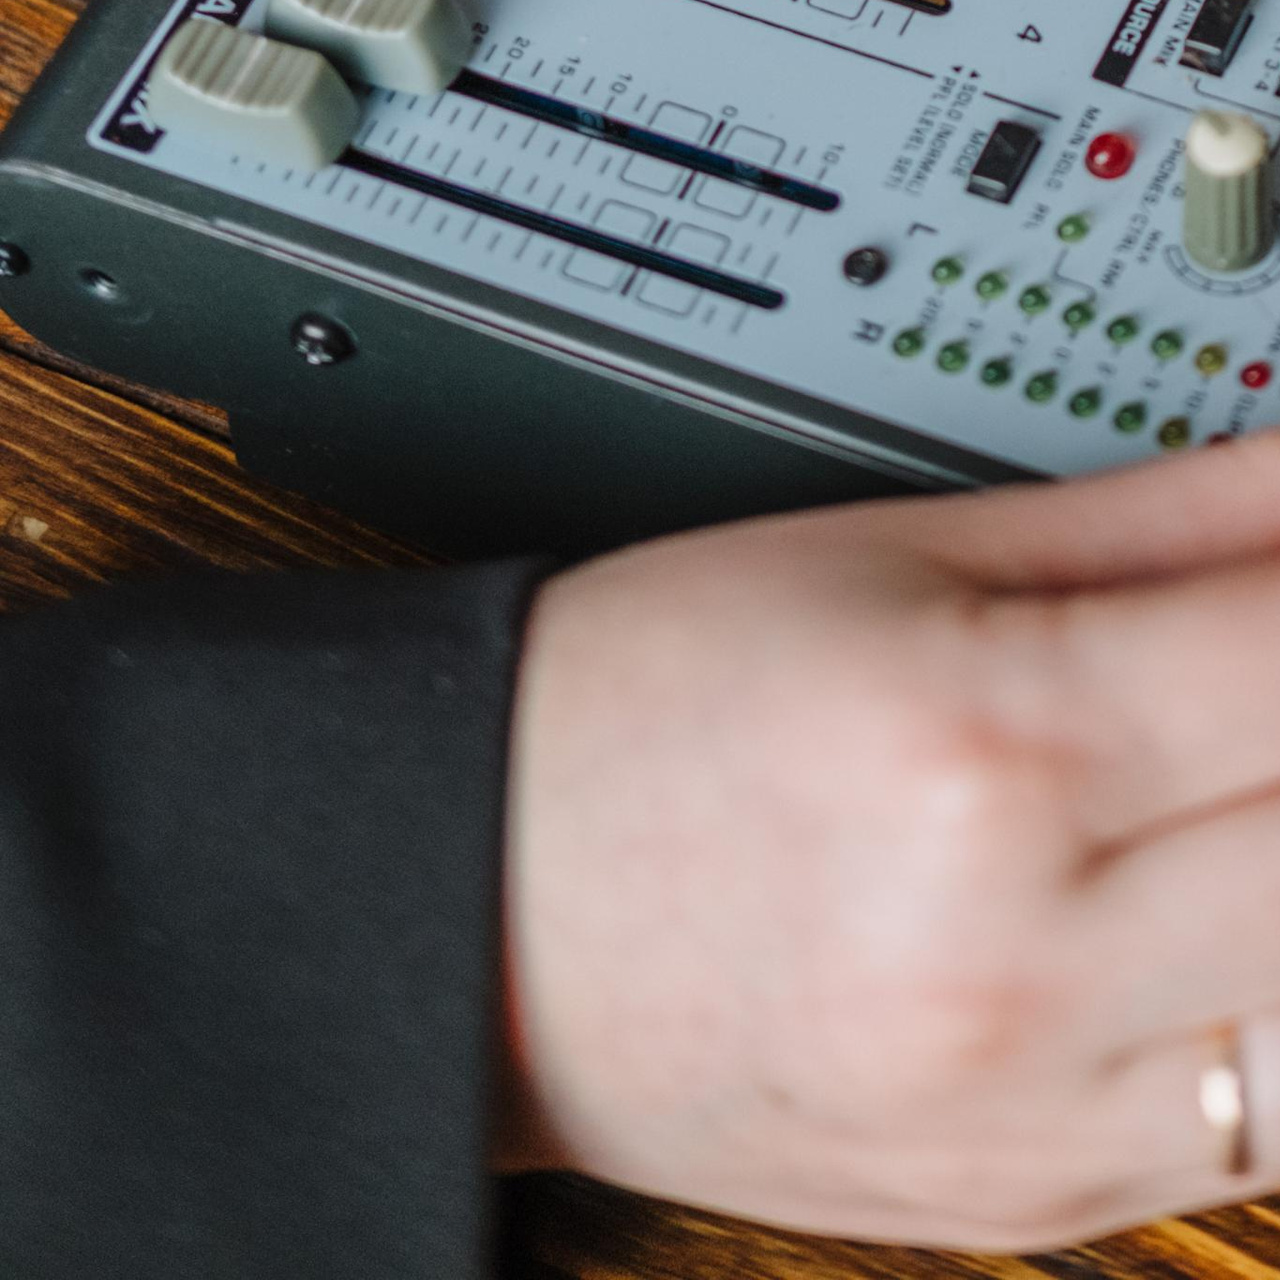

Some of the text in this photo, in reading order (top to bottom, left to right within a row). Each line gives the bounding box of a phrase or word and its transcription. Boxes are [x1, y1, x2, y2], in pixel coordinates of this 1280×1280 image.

[1016, 24, 1043, 44] 4
[507, 35, 531, 61] 20
[1152, 39, 1179, 68] MIX
[558, 54, 582, 77] 15
[1255, 59, 1280, 93] 3-4
[609, 72, 634, 95] 10
[1070, 105, 1101, 147] MAIN
[822, 142, 847, 166] 10
[951, 127, 989, 178] MODE
[907, 221, 939, 238] L
[856, 319, 885, 342] R
